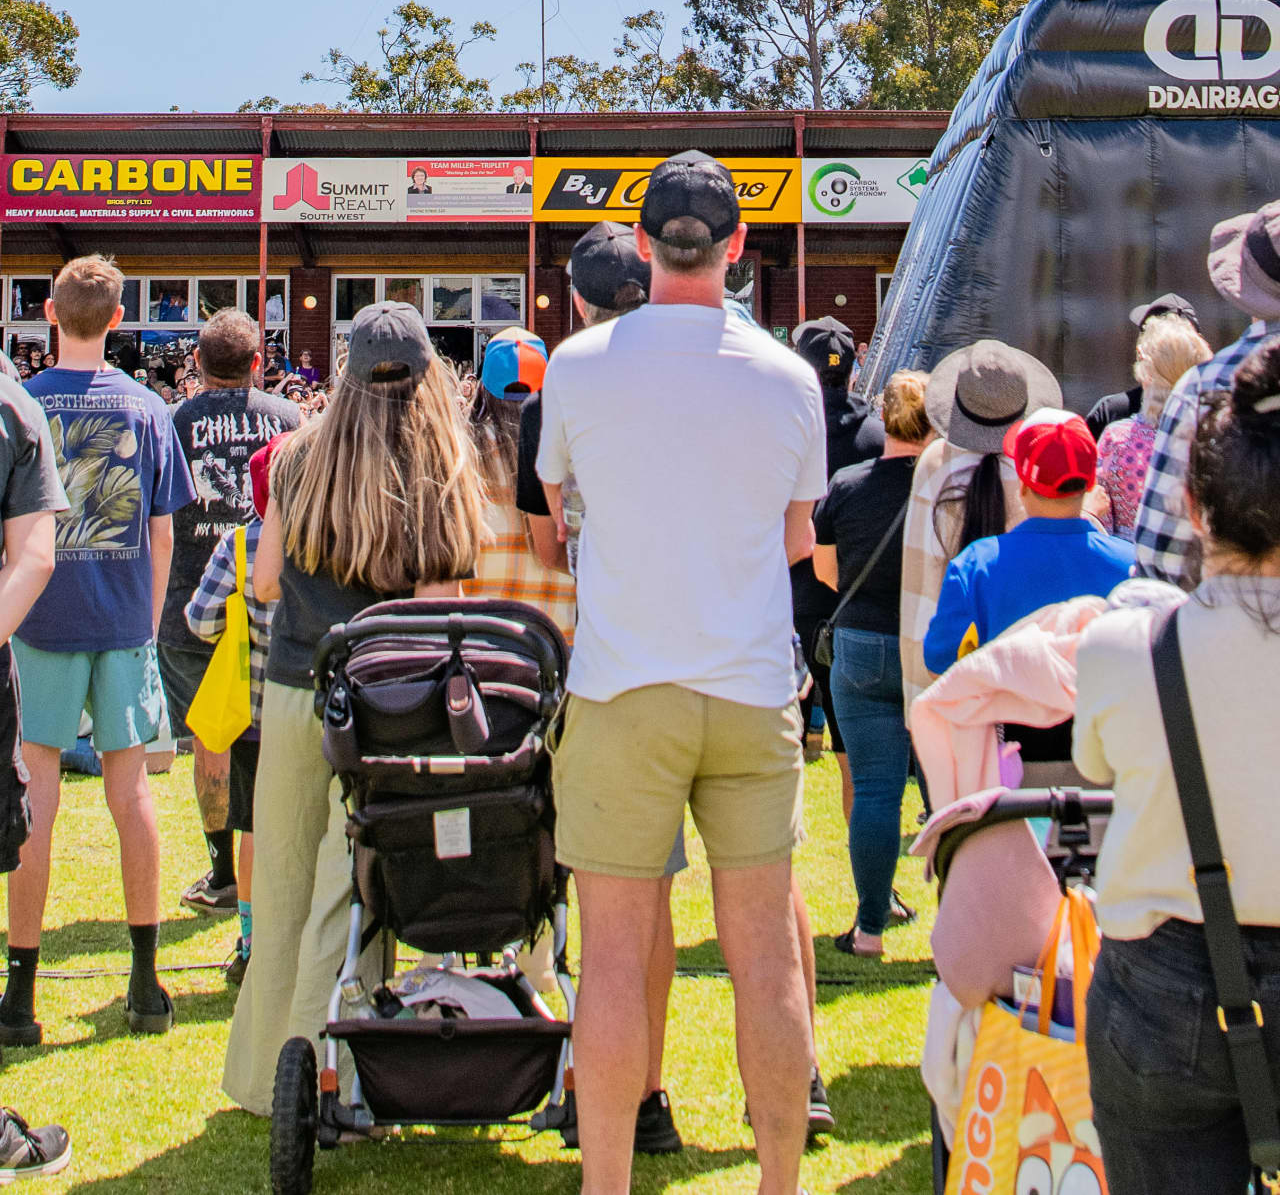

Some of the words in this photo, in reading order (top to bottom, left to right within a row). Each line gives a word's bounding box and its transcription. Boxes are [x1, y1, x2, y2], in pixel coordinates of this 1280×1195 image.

[11, 159, 253, 191] CARBONE
[320, 182, 389, 196] SUMMIT
[562, 174, 607, 204] B&J
[6, 209, 33, 217] HEAVY
[36, 209, 78, 218] HAULAGE,
[80, 209, 127, 217] MATERIALS
[129, 209, 161, 217] SUPPLY
[163, 209, 170, 217] &
[172, 209, 194, 217] CIVIL
[196, 209, 255, 217] EARTHWORKS
[333, 197, 396, 211] REALTY
[191, 412, 282, 450] CHILLIN
